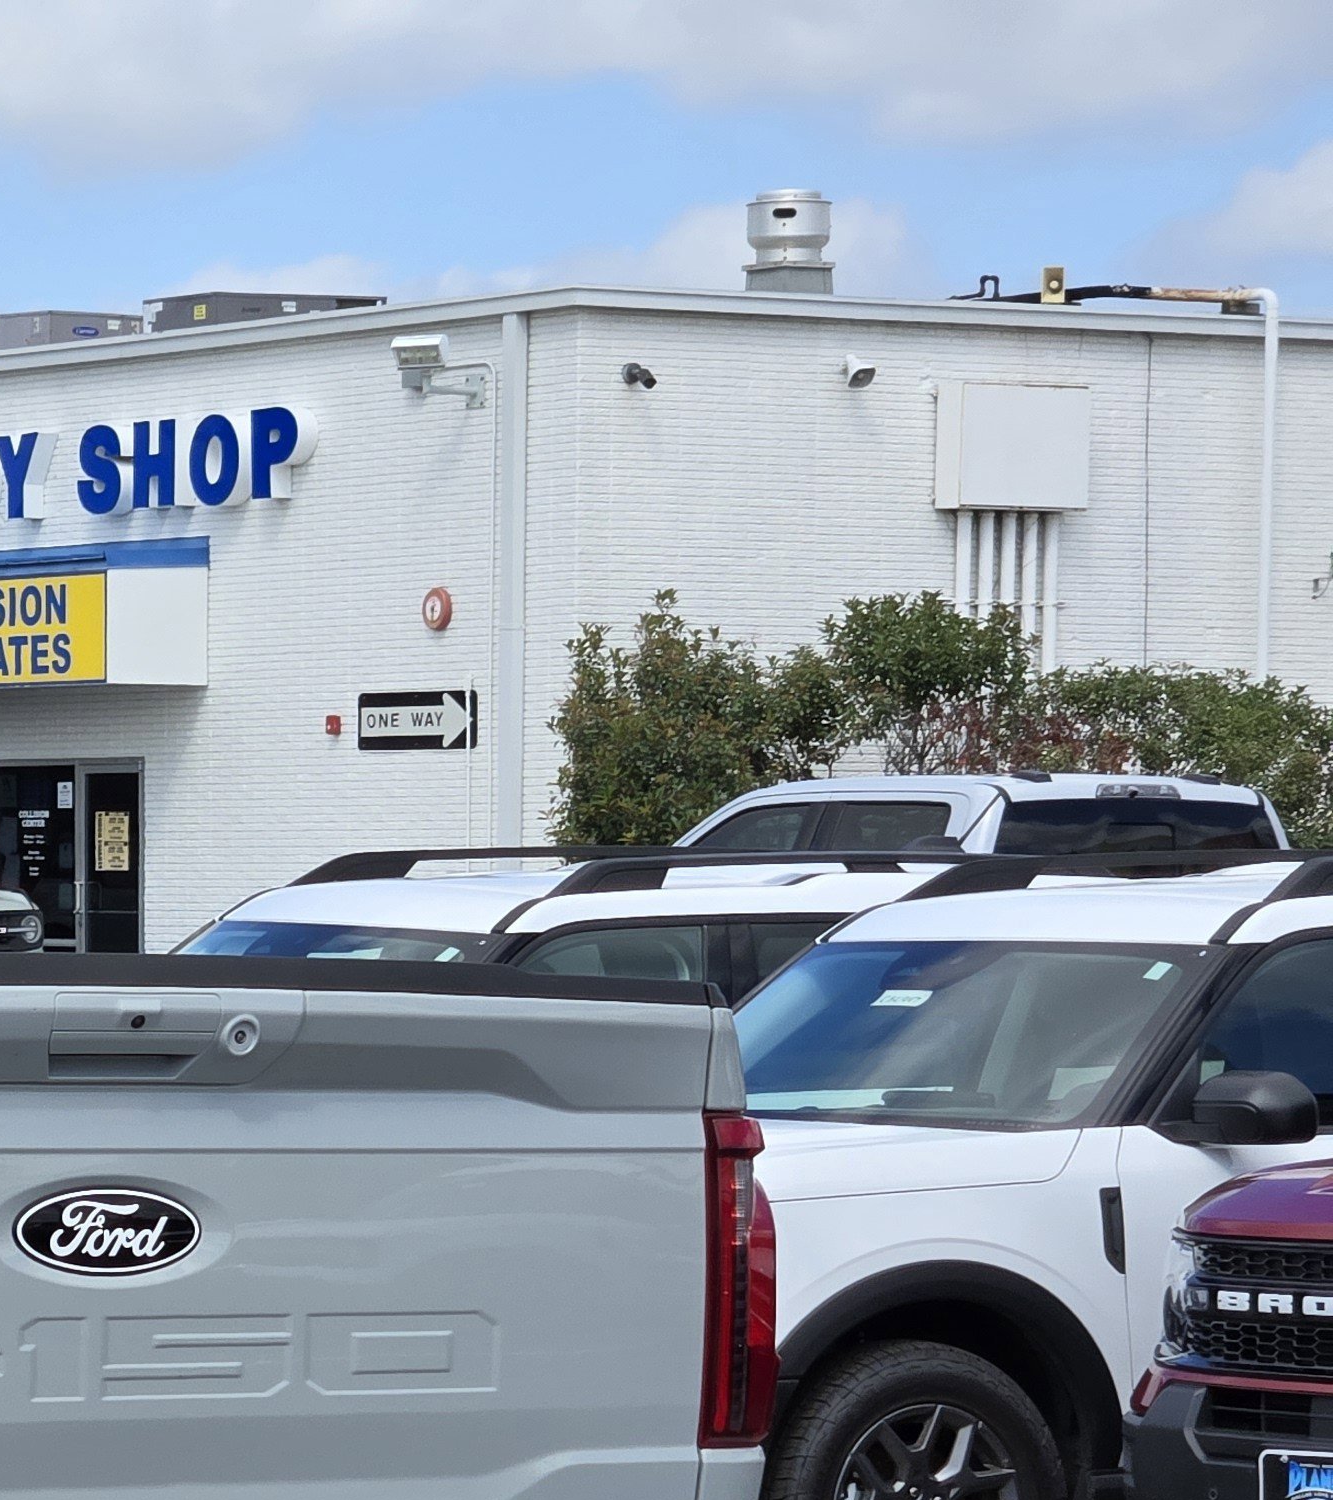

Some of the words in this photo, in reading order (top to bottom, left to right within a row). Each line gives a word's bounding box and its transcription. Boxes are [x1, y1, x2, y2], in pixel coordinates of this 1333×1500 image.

[77, 407, 300, 516] SHOP
[367, 713, 400, 728] ONE
[411, 711, 444, 726] WAY
[49, 1200, 169, 1259] Ford
